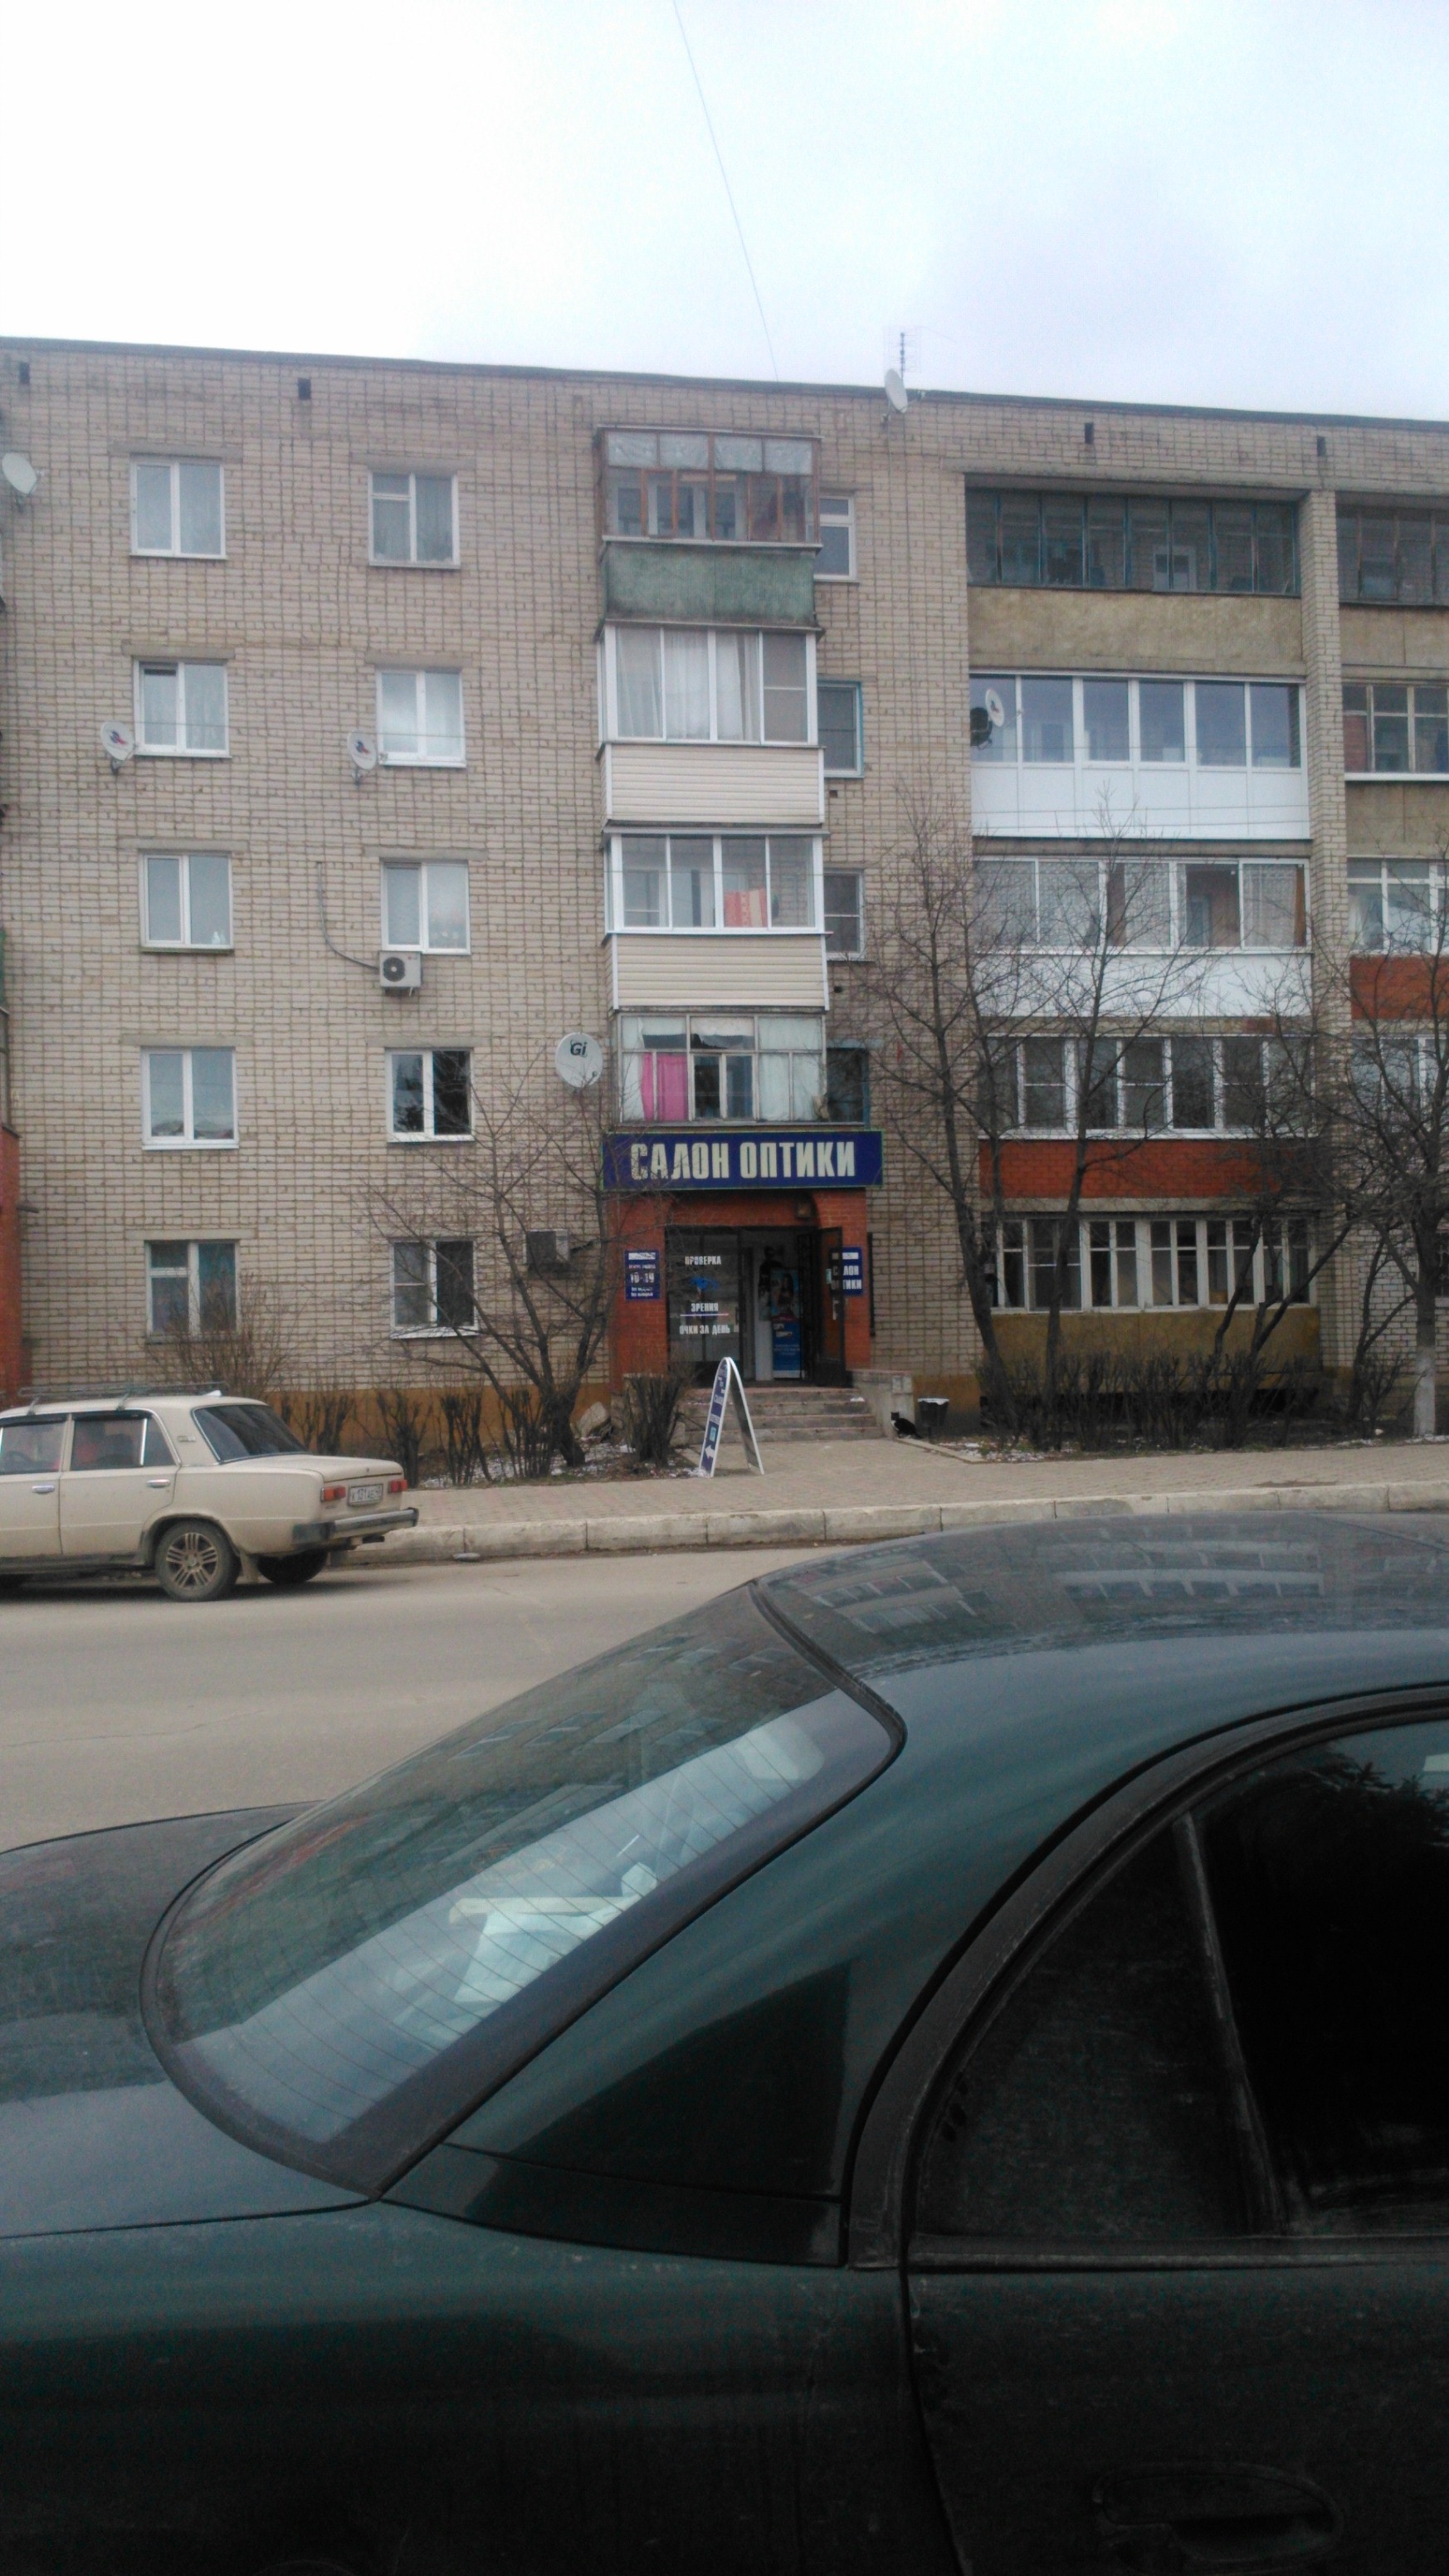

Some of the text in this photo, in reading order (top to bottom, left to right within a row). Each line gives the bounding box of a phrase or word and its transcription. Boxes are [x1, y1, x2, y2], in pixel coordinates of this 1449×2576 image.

[631, 1141, 856, 1179] САЛОН ОПТИКИ
[685, 1256, 721, 1265] ПРОВЕРКА
[832, 1265, 859, 1276] СЛОН
[691, 1303, 719, 1312] ЗРЕНИЯ
[680, 1325, 698, 1334] ОЧКИ
[700, 1325, 710, 1334] ЗА
[712, 1325, 730, 1335] ДЕНЬ
